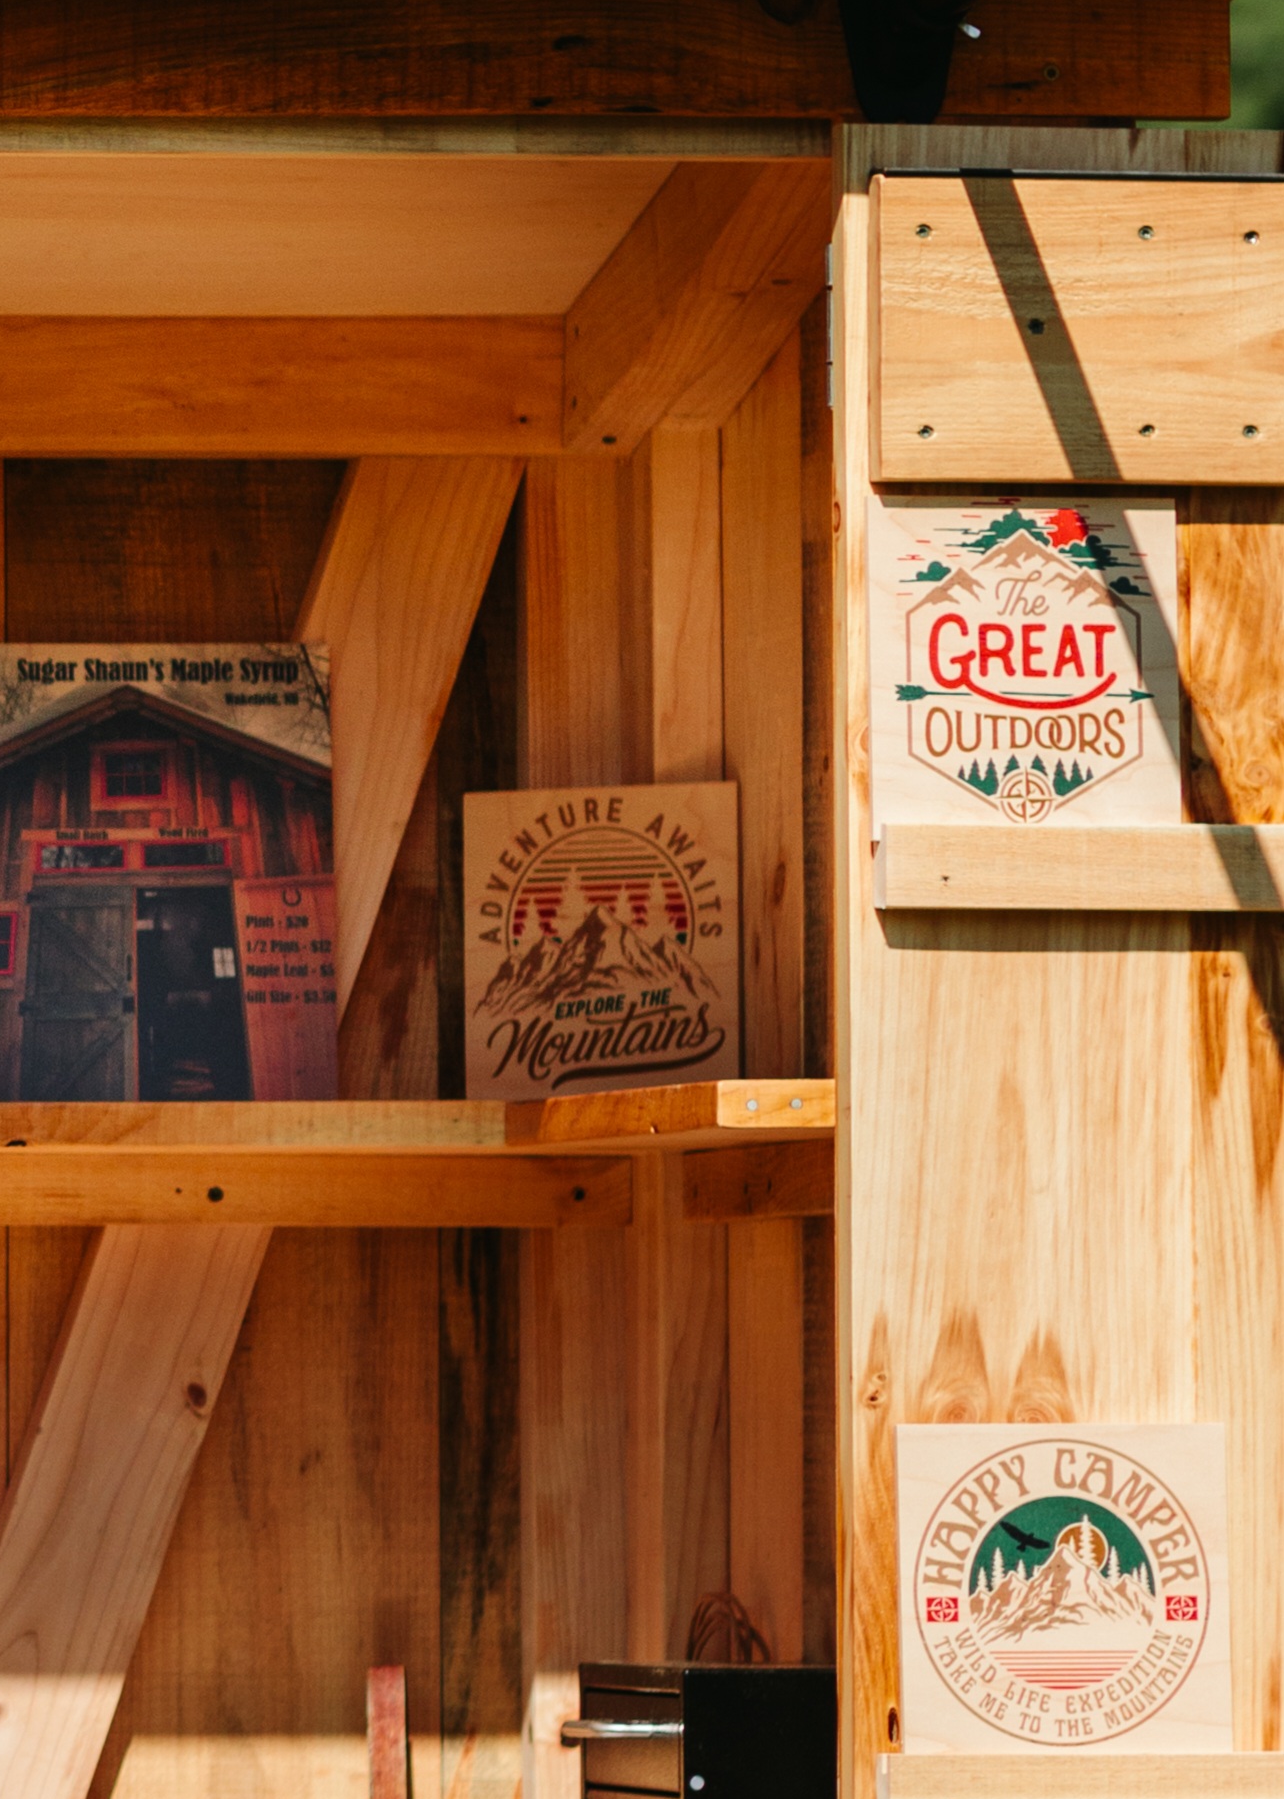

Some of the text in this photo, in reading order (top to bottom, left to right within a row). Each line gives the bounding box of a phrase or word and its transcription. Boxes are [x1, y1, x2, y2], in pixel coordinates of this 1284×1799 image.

[995, 570, 1050, 617] The
[17, 658, 299, 684] Sugar Shaun's Maple Syrup
[929, 613, 1117, 710] GREAT
[925, 706, 1126, 759] OUTDOORS
[479, 797, 723, 946] ADVENTURE AWAITS
[486, 1002, 726, 1084] Mountains
[554, 987, 672, 1021] EXPLORE THE
[922, 1448, 1200, 1589] HAPPY CAMPER
[933, 1634, 1193, 1737] TAKE ME TO THE MOUNTAINS
[955, 1627, 1173, 1714] WILD LIFE EXPEDITION
